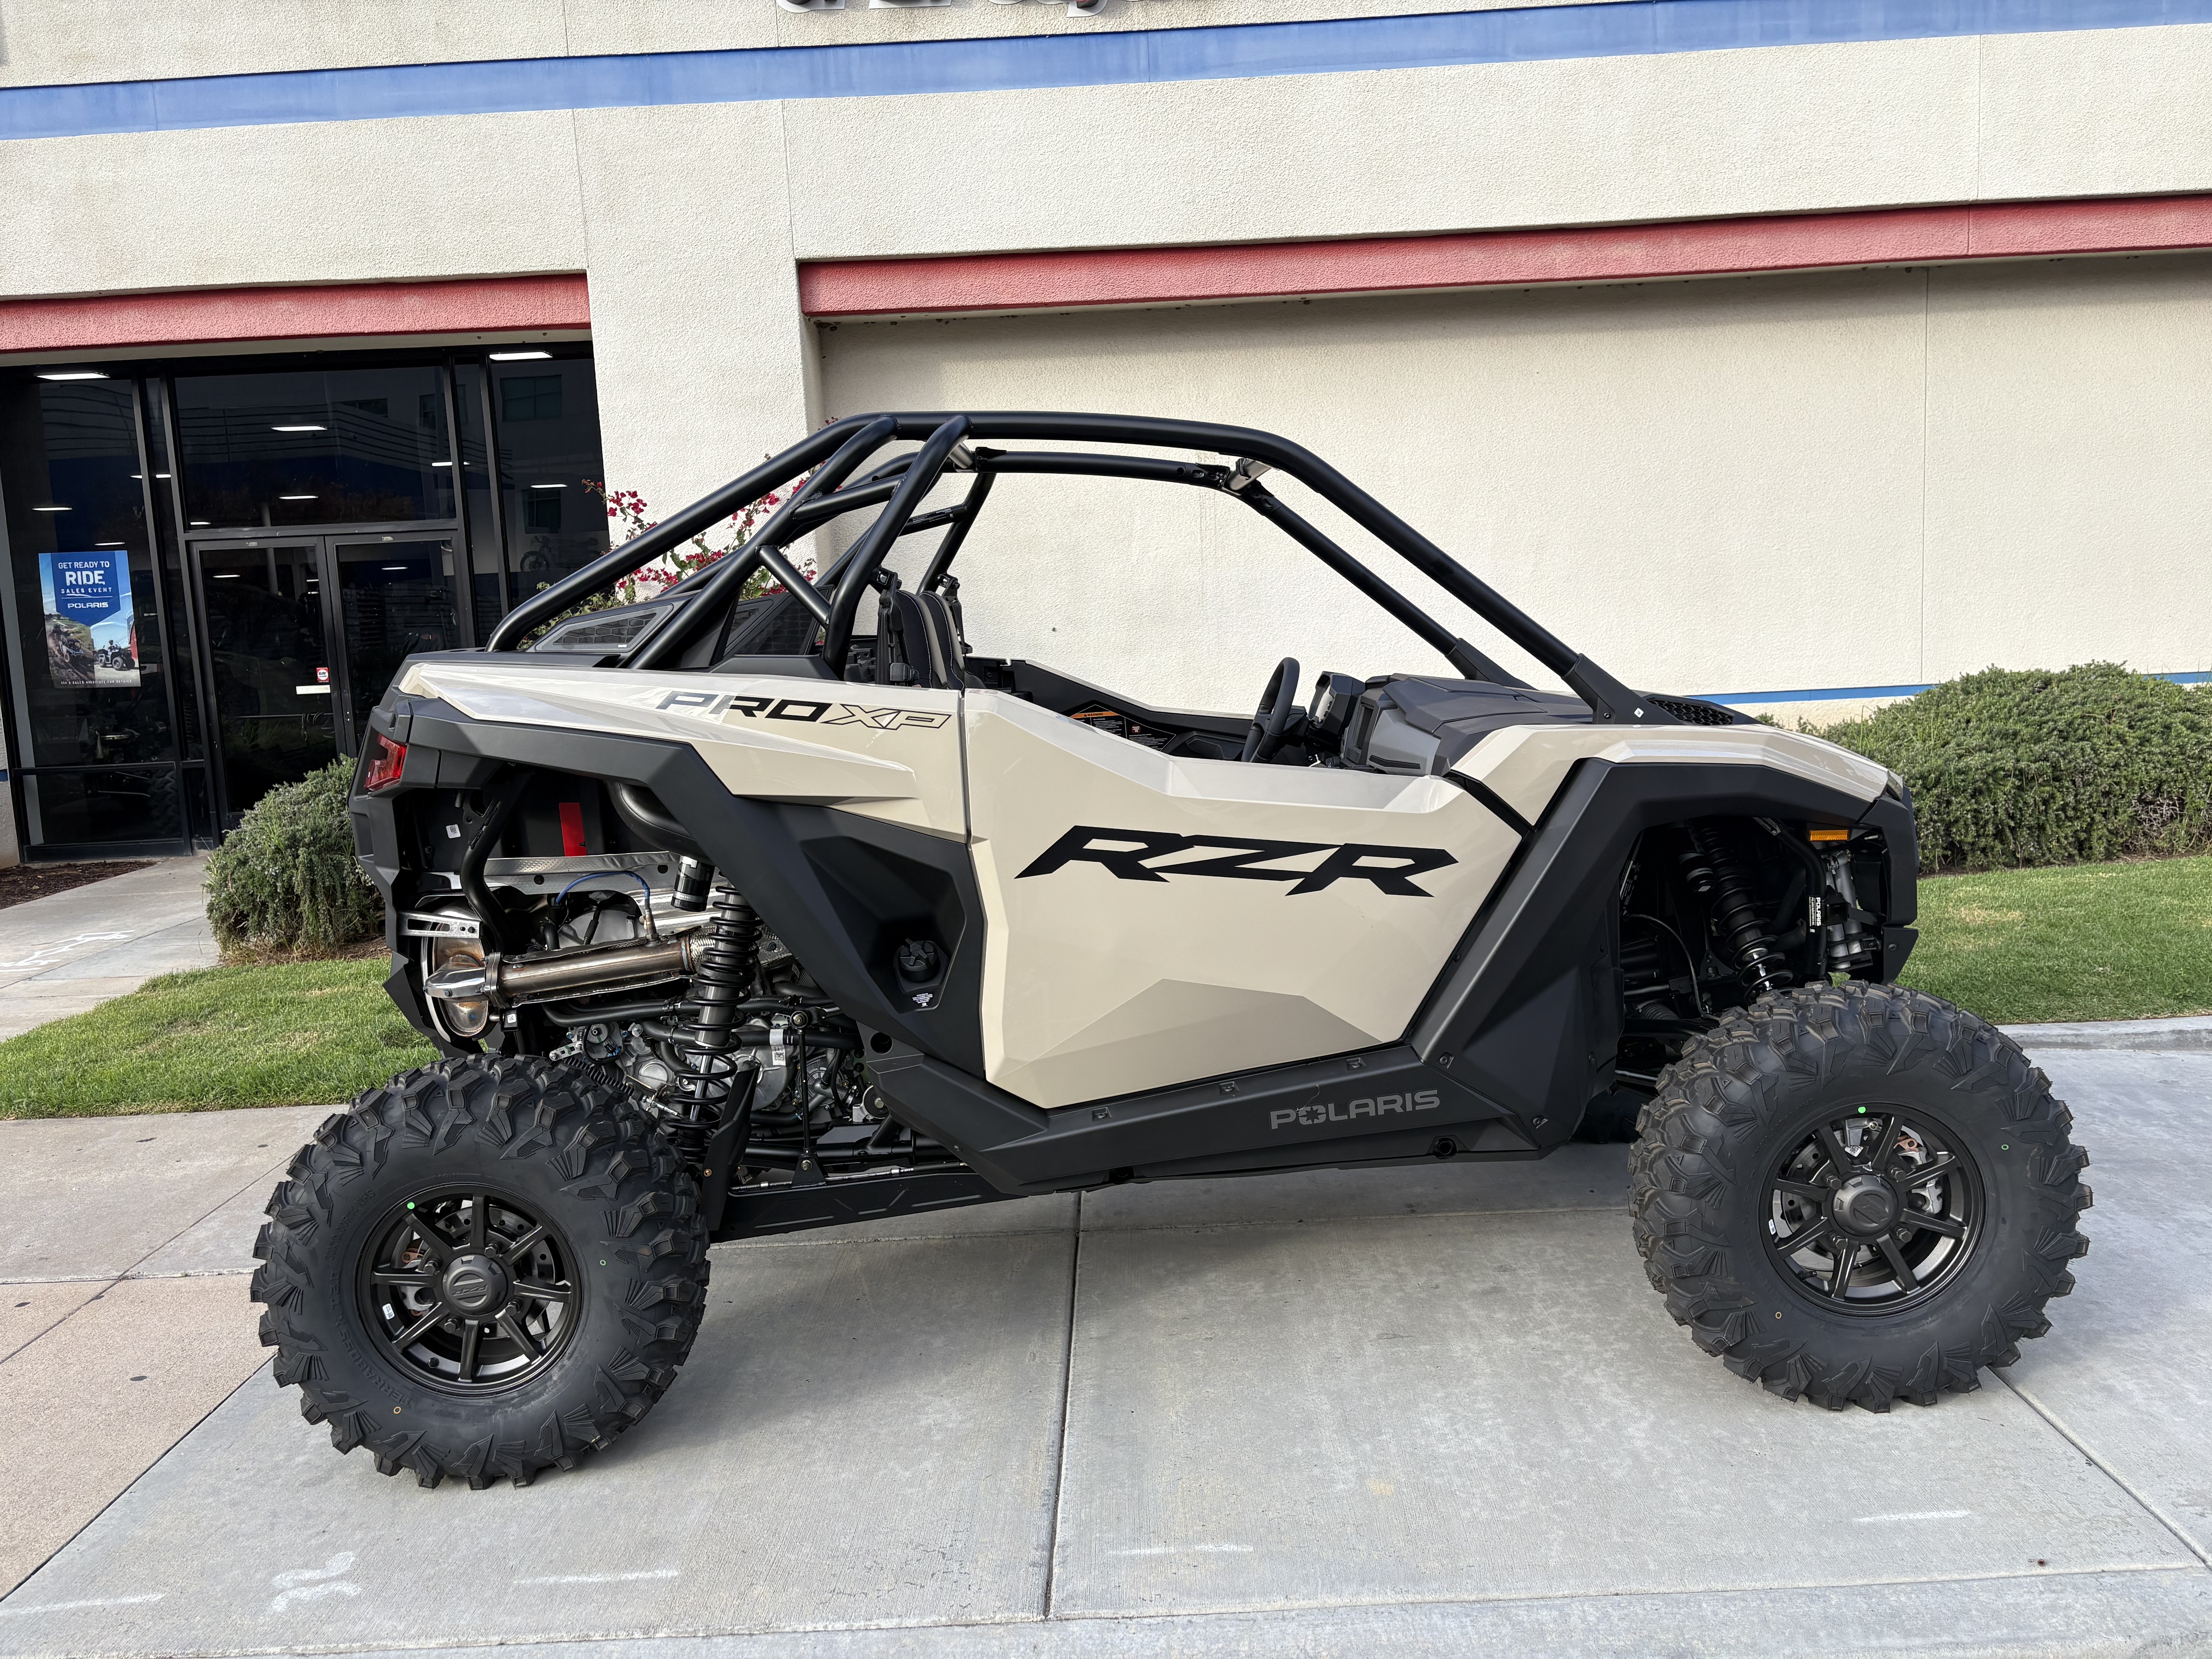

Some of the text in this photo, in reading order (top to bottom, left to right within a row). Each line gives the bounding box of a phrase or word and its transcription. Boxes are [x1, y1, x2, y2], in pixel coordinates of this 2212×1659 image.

[65, 570, 106, 586] RIDE
[1013, 825, 1459, 898] RZR
[1270, 1089, 1440, 1130] POLARIS
